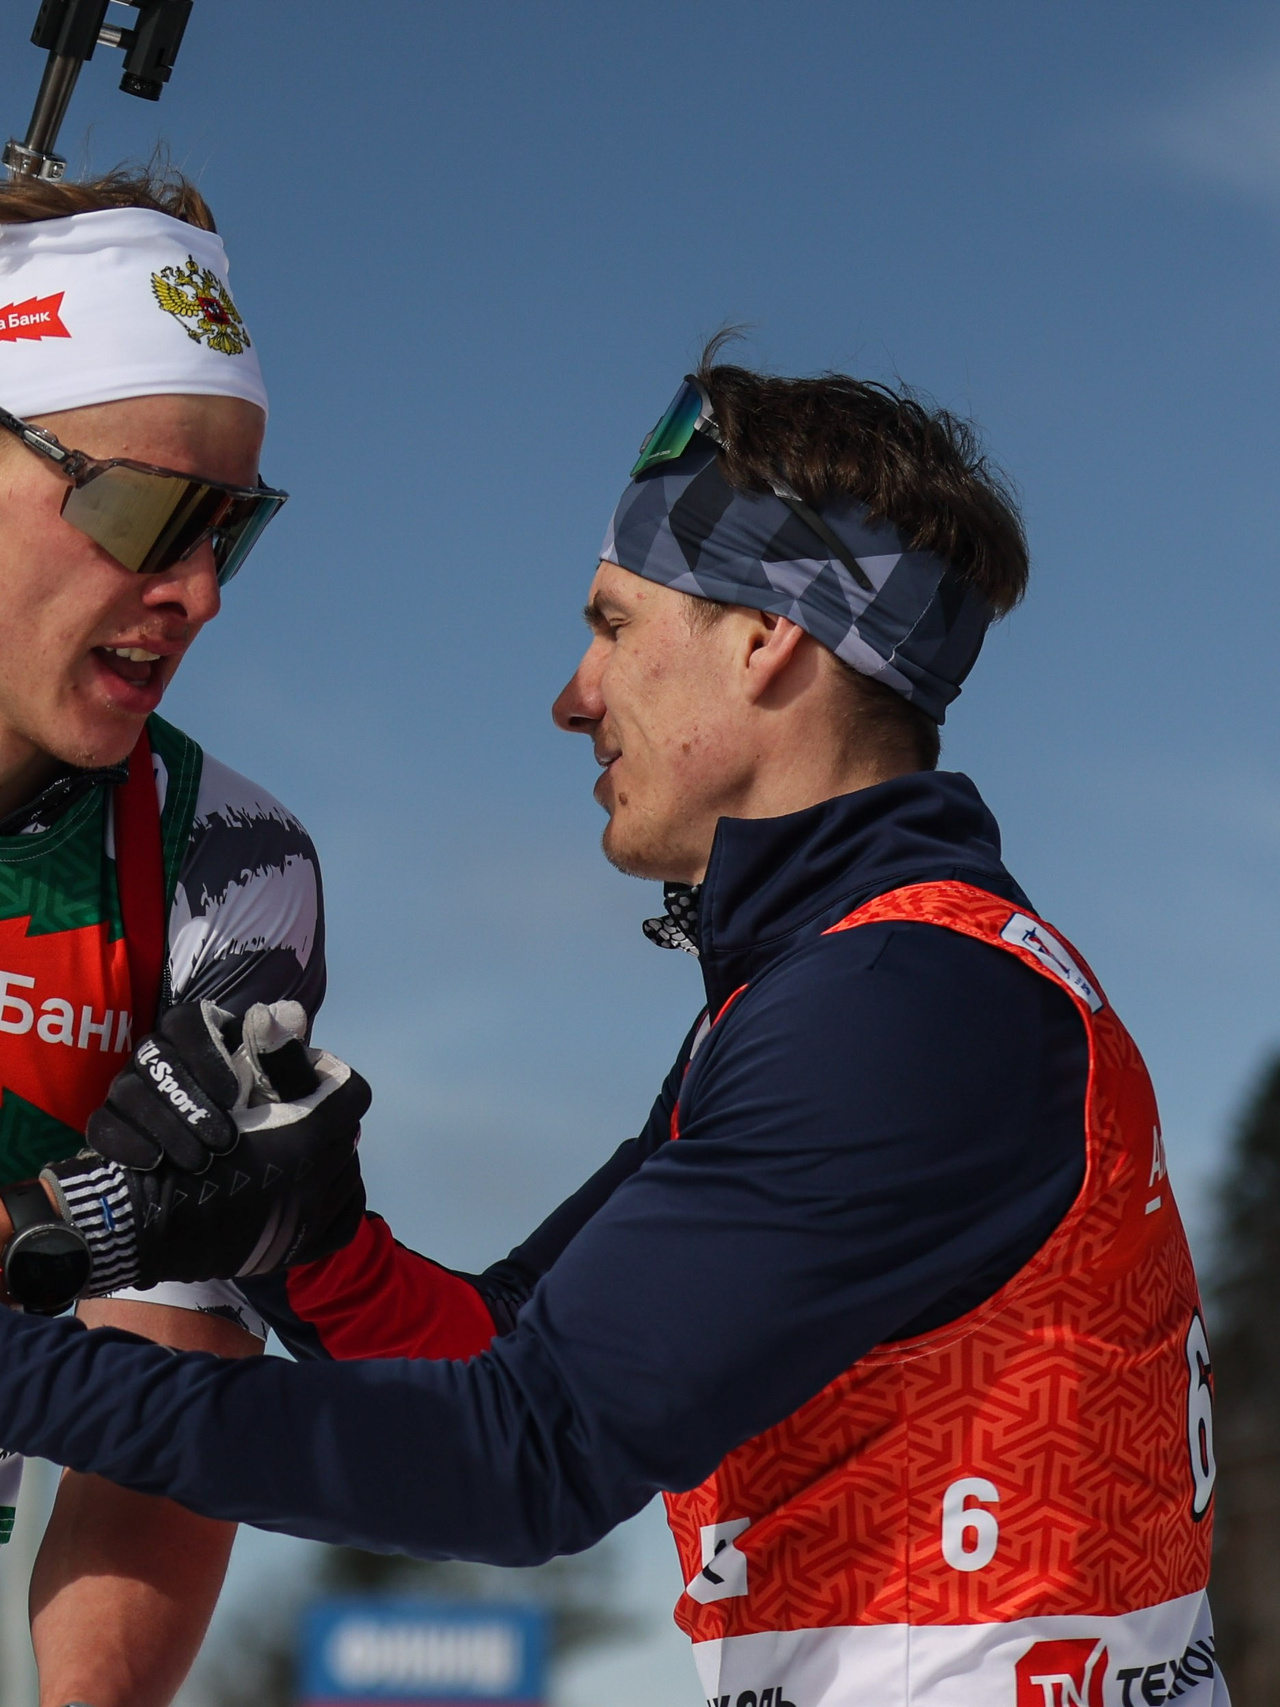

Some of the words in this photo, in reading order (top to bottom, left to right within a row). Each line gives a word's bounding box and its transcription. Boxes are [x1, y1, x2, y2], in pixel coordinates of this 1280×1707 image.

[8, 312, 51, 328] Банк
[1186, 1306, 1217, 1523] 6
[941, 1477, 1000, 1573] 6
